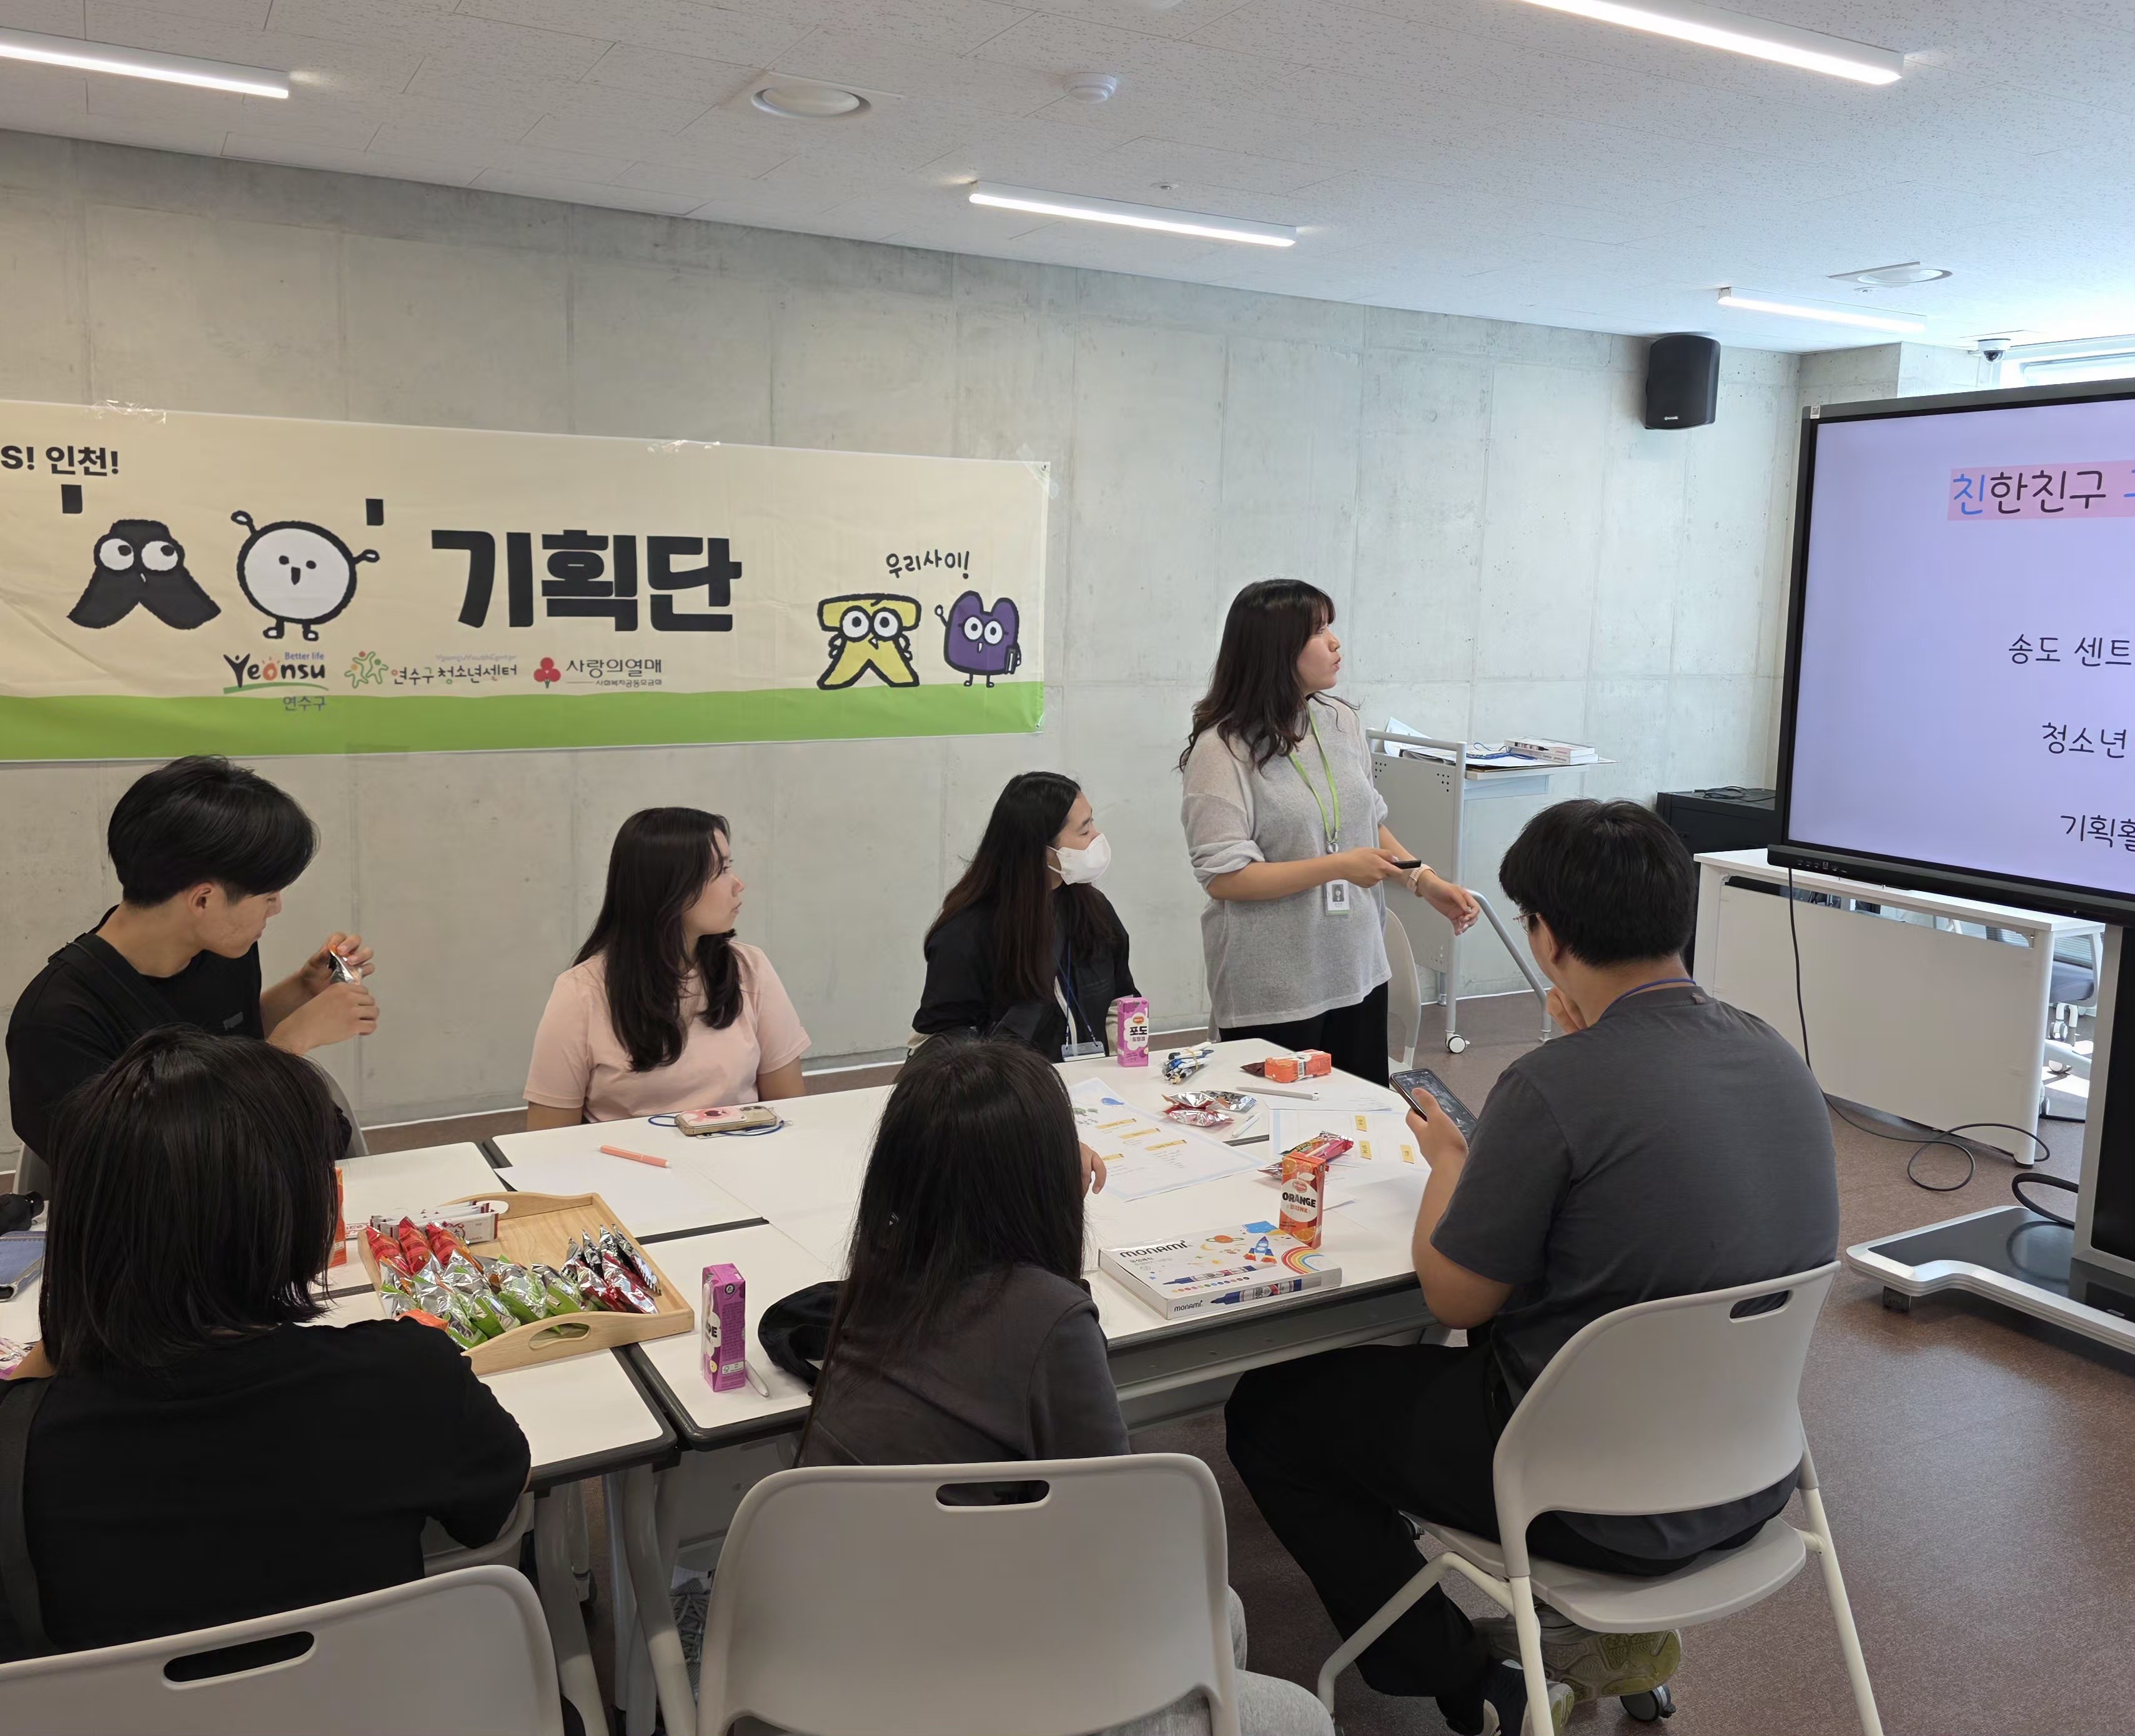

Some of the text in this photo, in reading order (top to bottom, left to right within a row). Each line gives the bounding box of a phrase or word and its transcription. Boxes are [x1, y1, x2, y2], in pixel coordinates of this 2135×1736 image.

[46, 445, 119, 476] 인천!
[1953, 469, 2106, 515] 친한친구
[886, 549, 969, 579] 우리사이!
[432, 530, 742, 633] 기획단
[284, 651, 325, 660] Better life
[2009, 634, 2132, 667] 송도 센트
[223, 653, 325, 688] Yeonsu
[566, 659, 661, 678] 사랑의열매
[283, 695, 326, 711] 연수구
[2042, 722, 2126, 758] 청소년
[1129, 1026, 1147, 1035] 포도
[1282, 1192, 1316, 1208] ORANGE
[1290, 1204, 1309, 1214] DRINK
